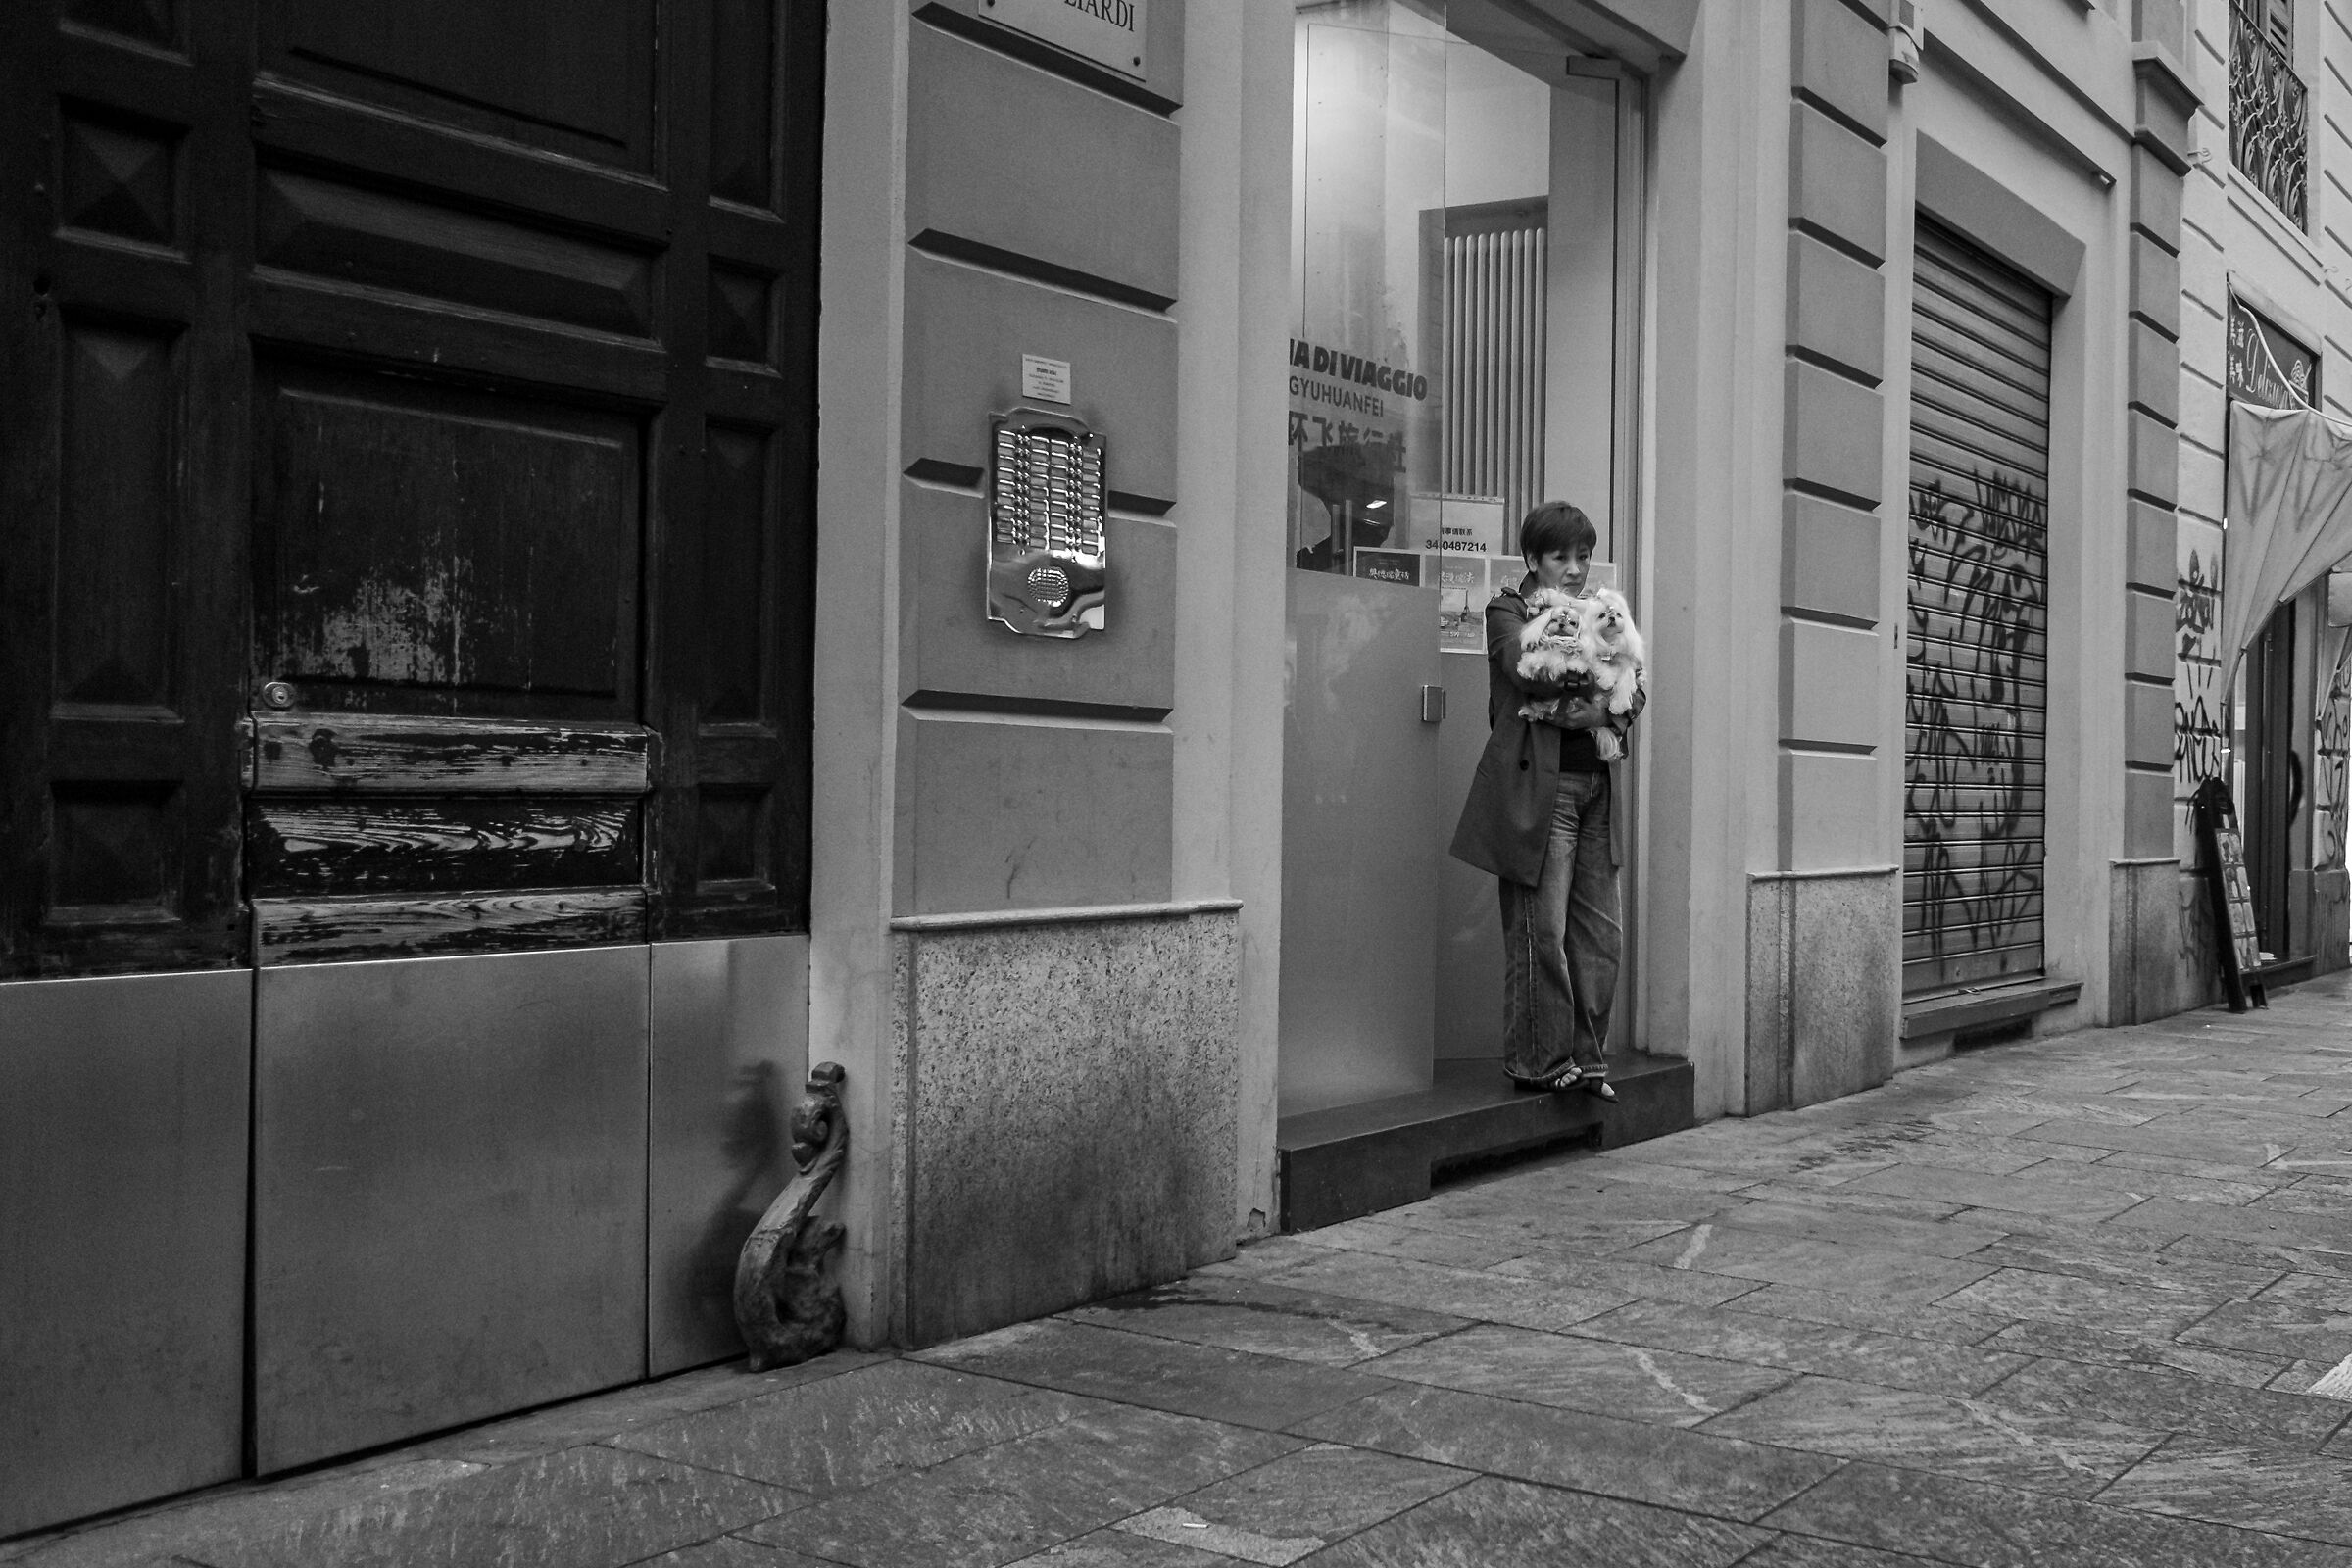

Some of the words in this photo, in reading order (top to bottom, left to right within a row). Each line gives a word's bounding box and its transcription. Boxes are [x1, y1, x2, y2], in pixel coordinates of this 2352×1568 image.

[1064, 0, 1135, 32] ARDI
[1313, 345, 1338, 377] DI
[1340, 353, 1428, 401] VIAGGIO
[1289, 375, 1384, 417] GYUHUANFEI
[1425, 539, 1487, 552] 340487214
